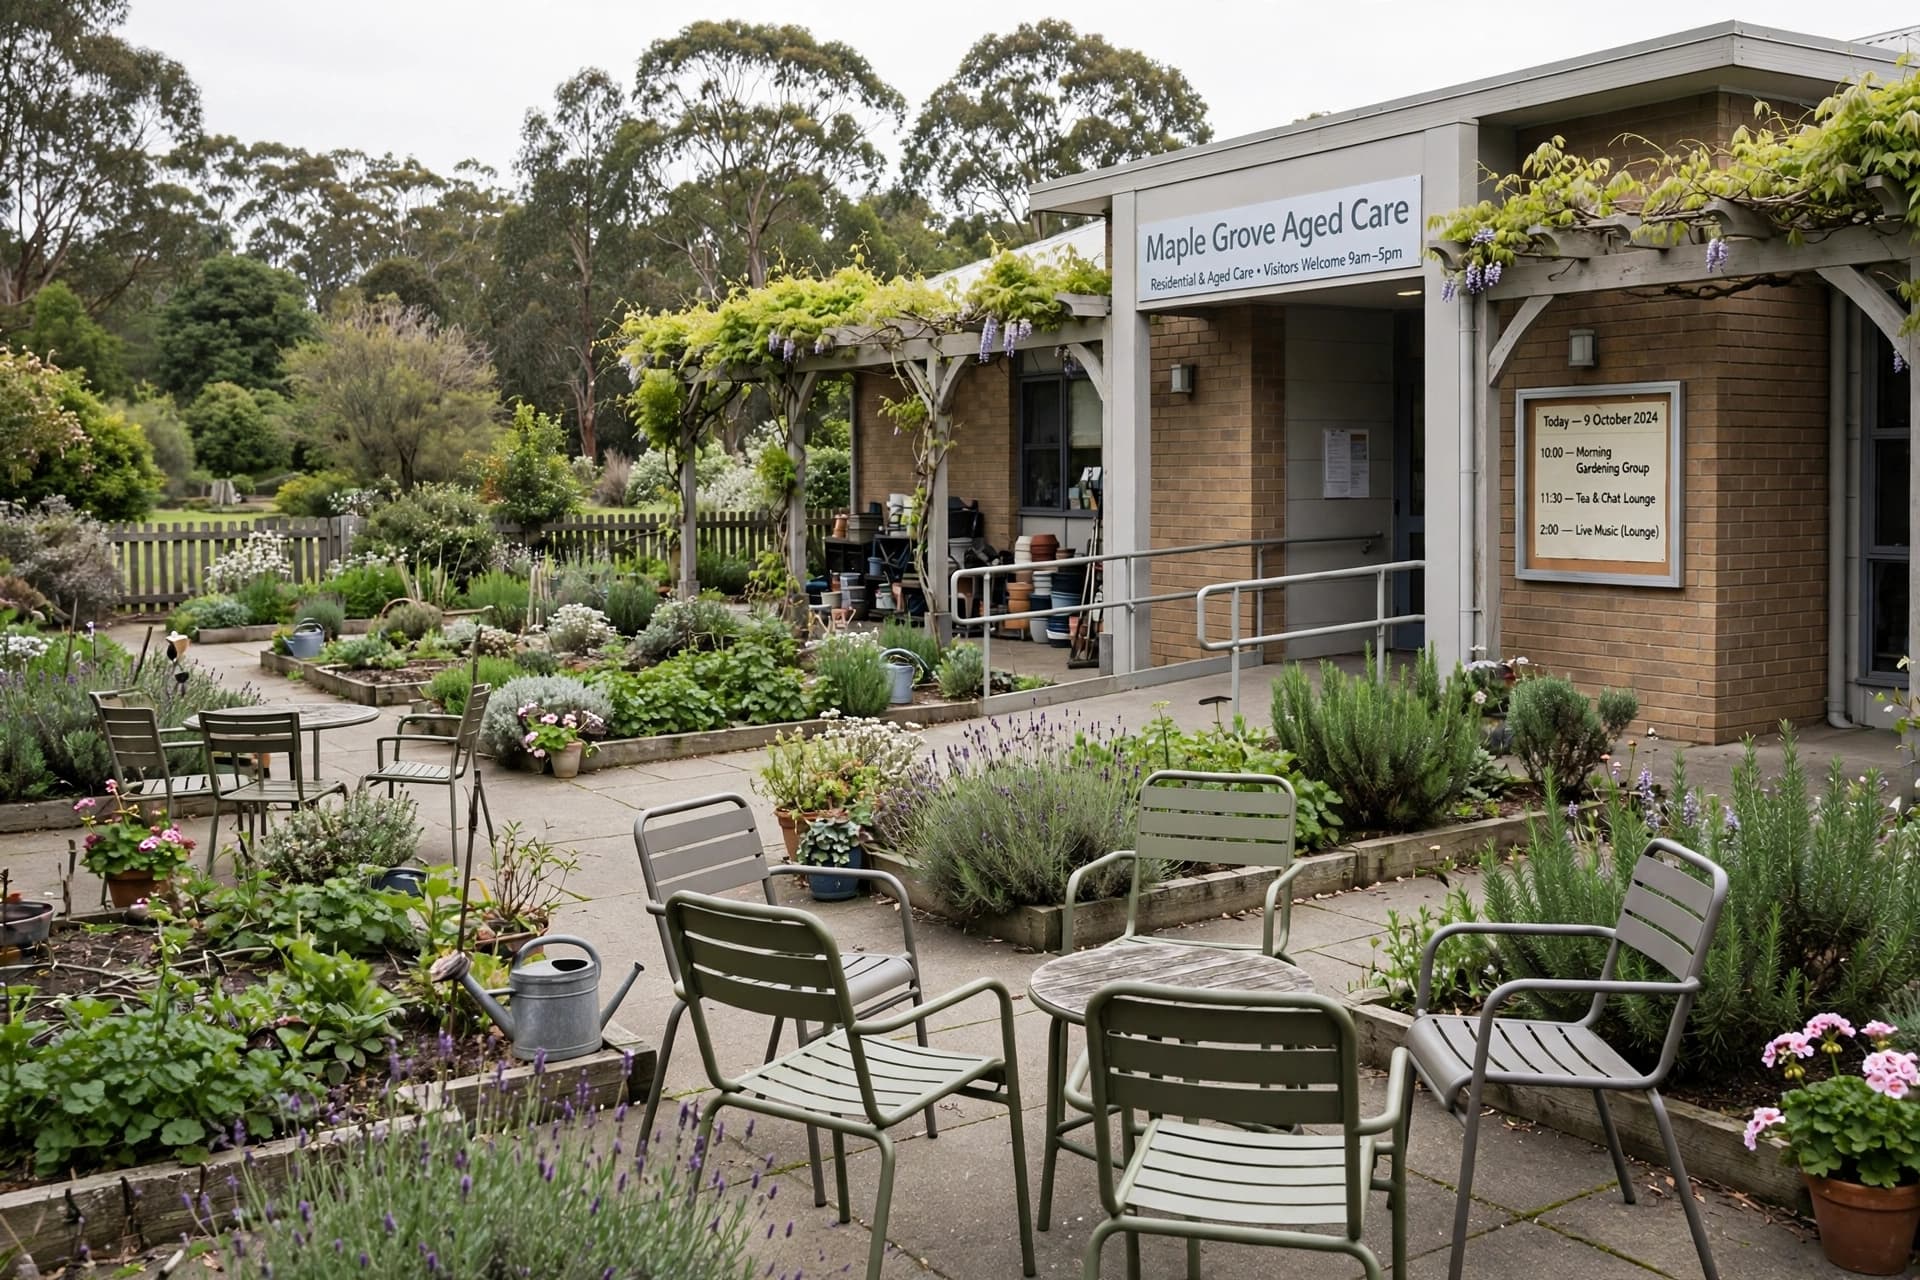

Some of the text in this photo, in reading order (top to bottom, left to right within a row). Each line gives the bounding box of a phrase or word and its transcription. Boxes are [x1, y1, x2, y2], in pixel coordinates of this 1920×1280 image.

[1146, 198, 1409, 265] Maple Grove Aged Care
[1151, 272, 1196, 291] Residential
[1199, 272, 1206, 284] &
[1208, 270, 1230, 287] Aged
[1234, 267, 1254, 280] Care
[1264, 262, 1299, 276] Visitors
[1301, 254, 1346, 271] Welcome
[1544, 415, 1569, 430] Today
[1584, 414, 1590, 426] 9
[1592, 413, 1631, 426] October
[1634, 412, 1658, 424] 2024
[1576, 446, 1611, 459] Morning
[1576, 462, 1650, 476] Gardening Group
[1541, 493, 1563, 503] 11:30
[1576, 493, 1590, 503] Tea
[1592, 493, 1599, 503] &
[1601, 493, 1621, 503] Chat
[1624, 493, 1656, 506] Lounge
[1540, 525, 1559, 535] 2:00
[1576, 525, 1593, 536] Live
[1594, 525, 1619, 536] Music
[1621, 525, 1660, 540] (Lounge)
